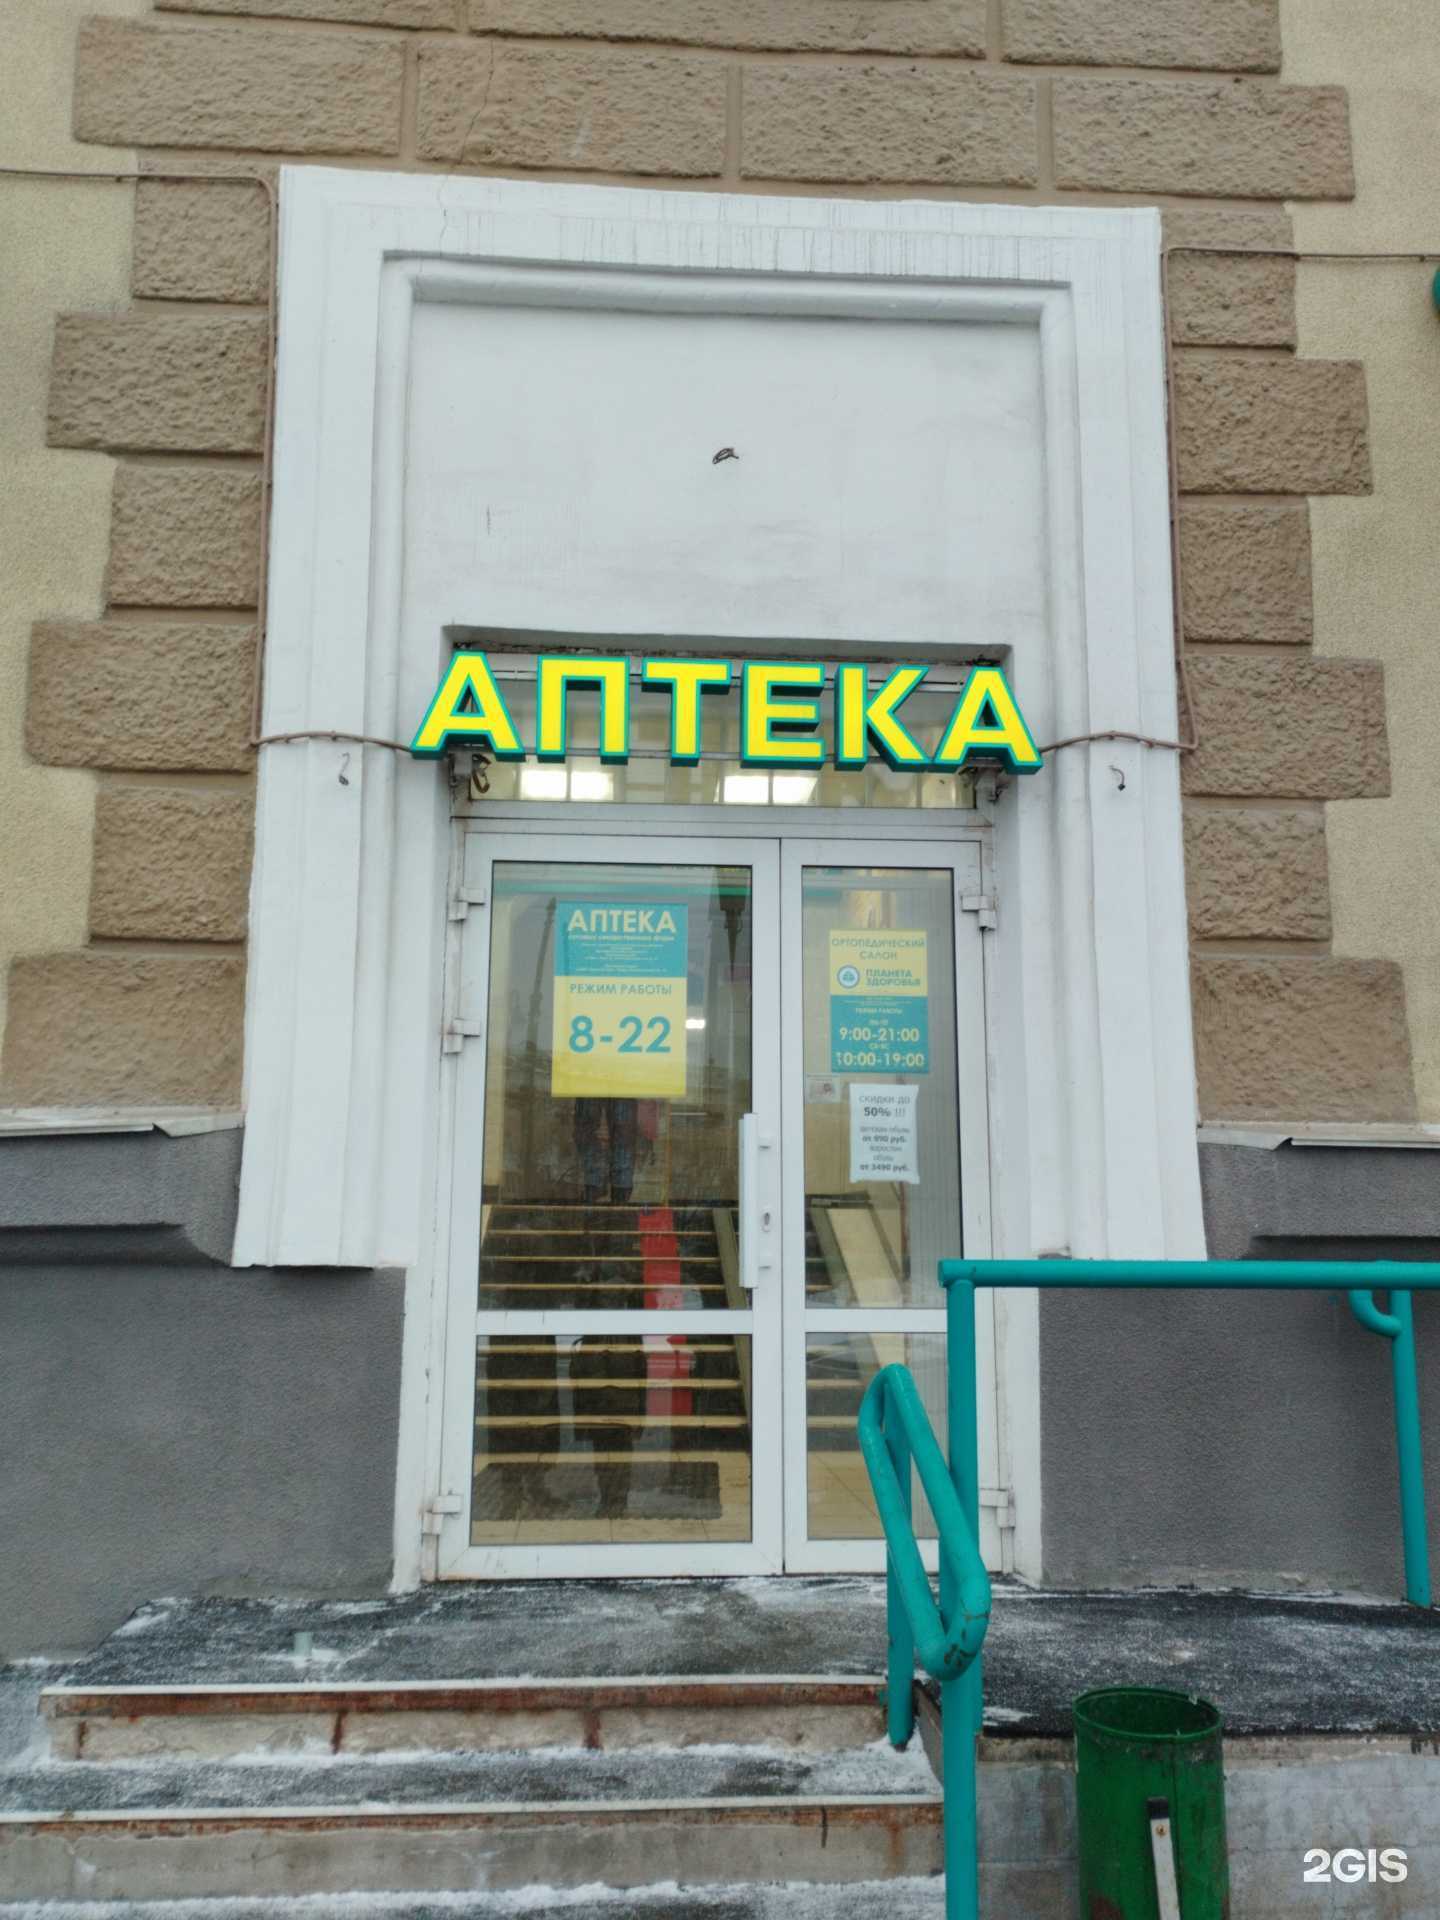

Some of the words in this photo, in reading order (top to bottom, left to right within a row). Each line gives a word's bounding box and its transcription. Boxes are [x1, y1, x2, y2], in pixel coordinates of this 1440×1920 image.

[411, 651, 1043, 774] АПТЕКА
[567, 909, 677, 933] АПТЕКА
[859, 950, 897, 960] САЛОН
[866, 968, 912, 978] ПЛАНЕТА
[866, 977, 921, 987] ЗДОРОВЬЯ
[570, 983, 617, 995] РЕЖИМ
[620, 983, 672, 996] РАБОТЫ
[568, 1014, 672, 1054] 8-22
[839, 1027, 920, 1042] 9:00-21:00
[836, 1051, 925, 1067] 10:00-19:00
[864, 1106, 892, 1117] 50%
